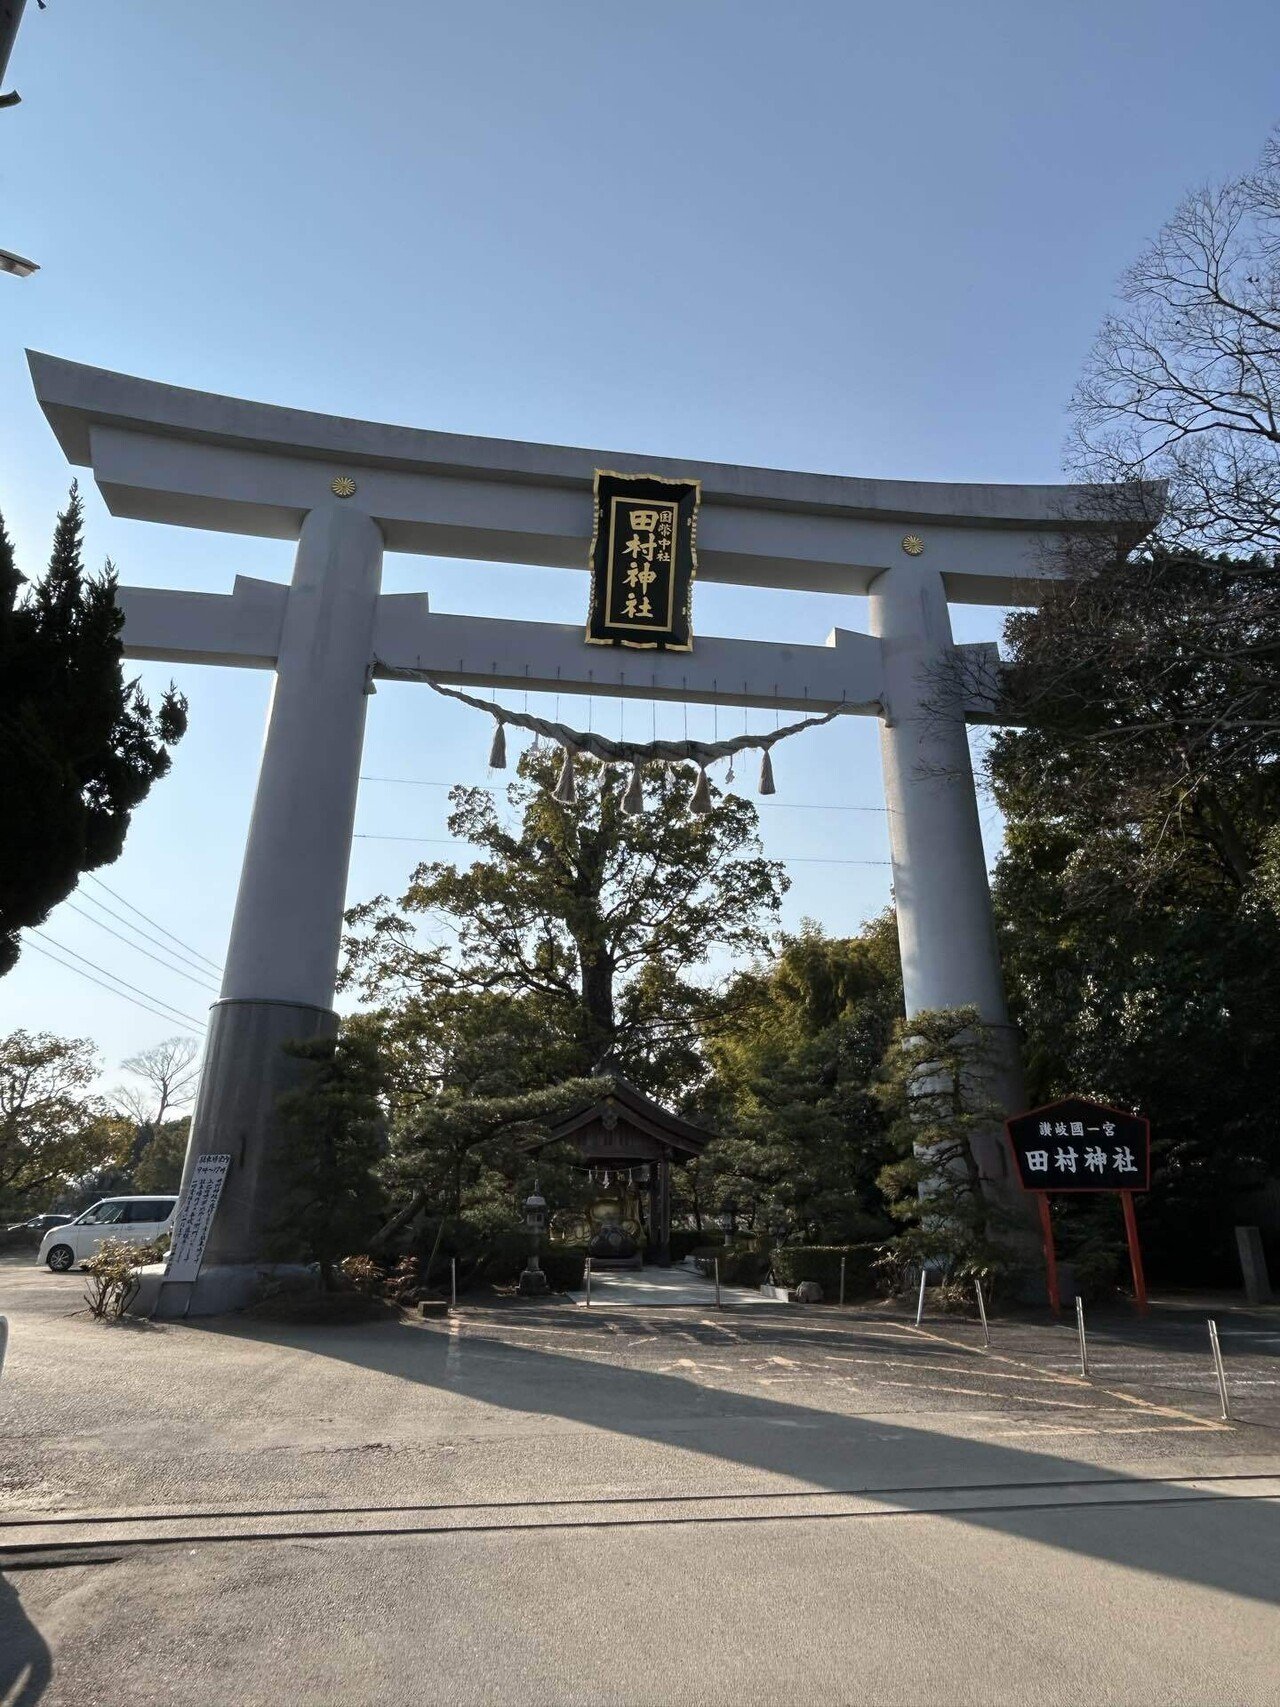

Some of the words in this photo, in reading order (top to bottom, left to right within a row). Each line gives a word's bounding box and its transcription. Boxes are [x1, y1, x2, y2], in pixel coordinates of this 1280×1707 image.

[620, 509, 660, 619] 田村神社
[1025, 1145, 1138, 1175] 田村神社
